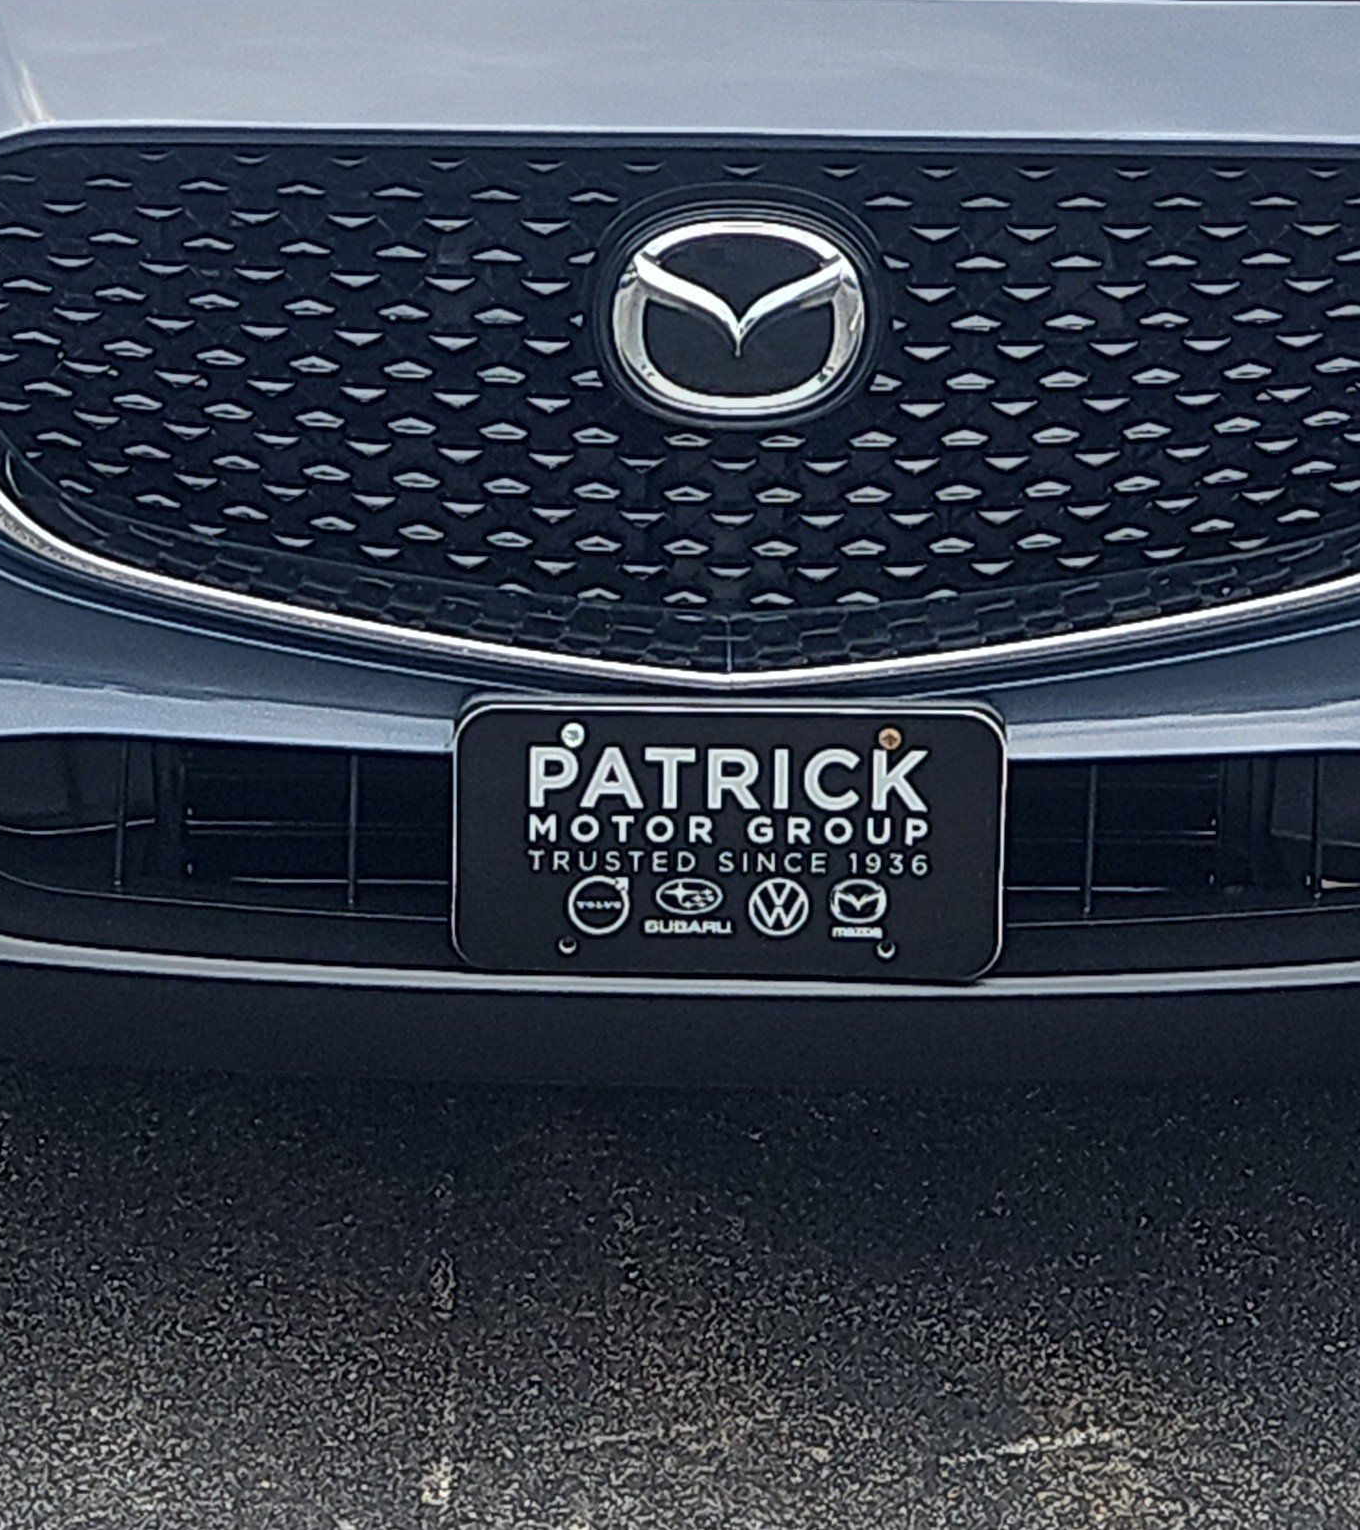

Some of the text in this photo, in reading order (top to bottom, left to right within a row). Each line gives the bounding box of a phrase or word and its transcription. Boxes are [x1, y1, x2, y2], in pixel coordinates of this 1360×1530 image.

[529, 746, 929, 813] PATRICK
[529, 814, 929, 846] MOTOR GROUP
[528, 850, 929, 876] TRUSTED SINCE 1936
[576, 900, 623, 910] VOLVO
[644, 919, 733, 935] SUBARU
